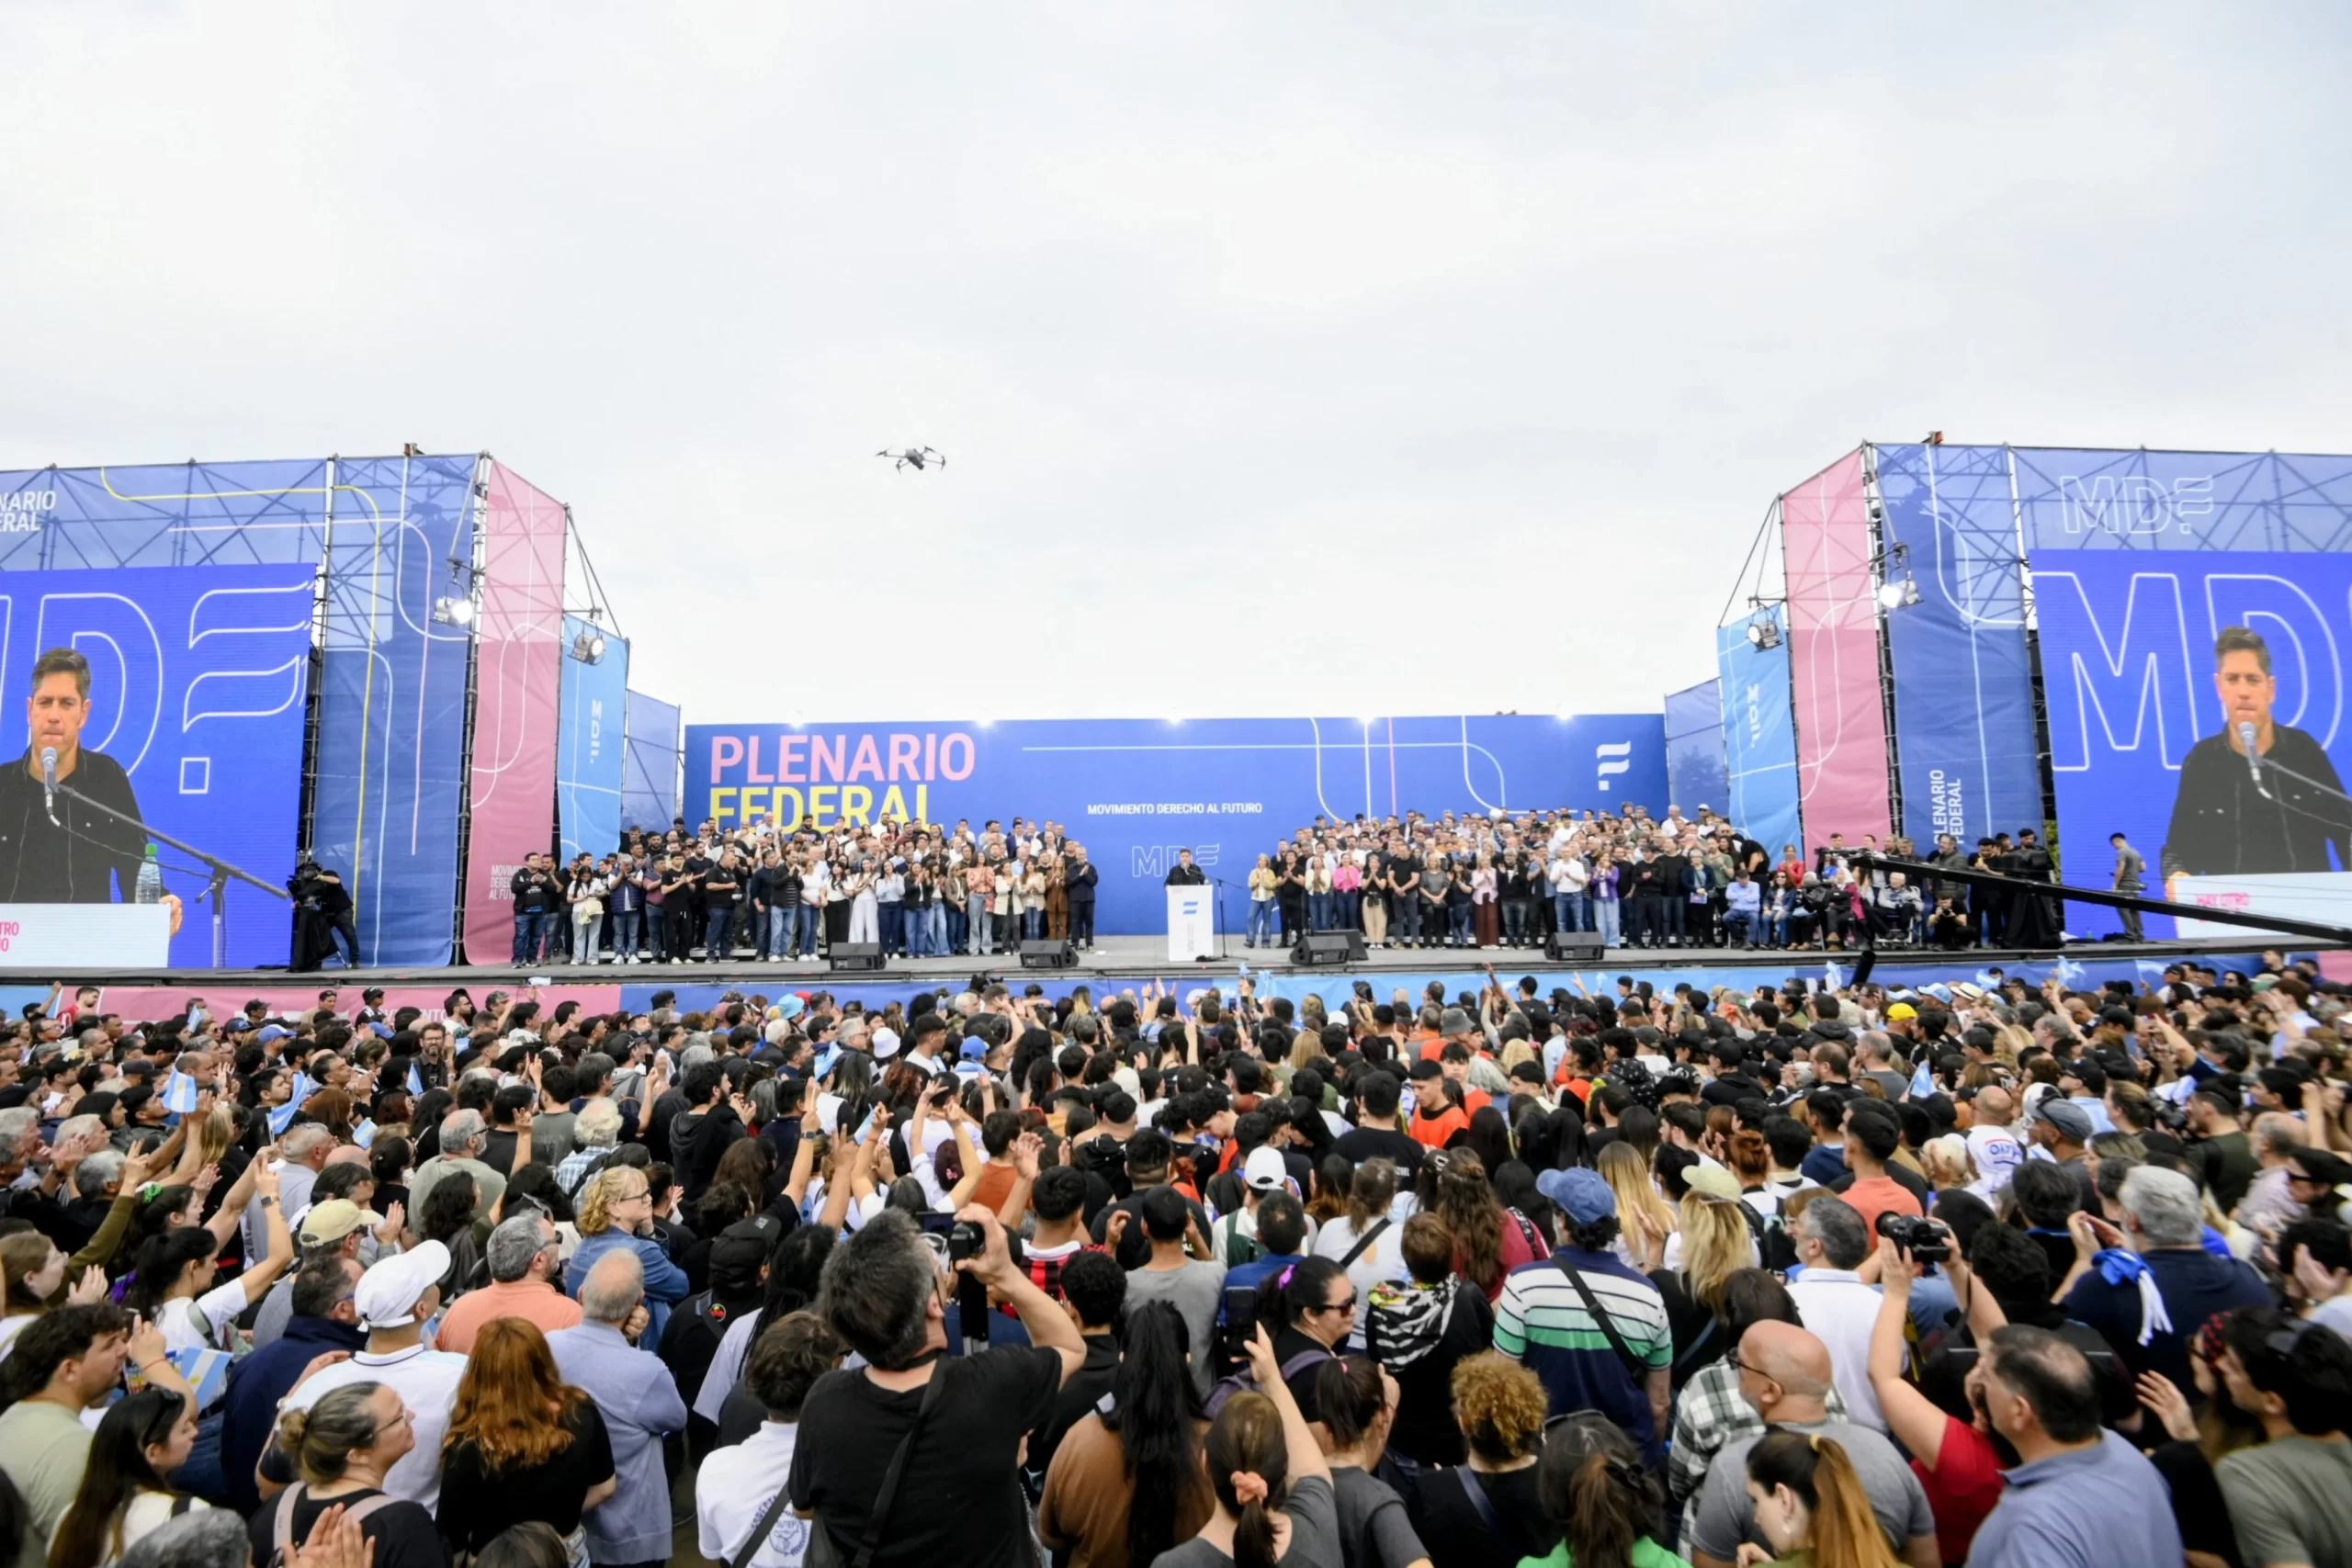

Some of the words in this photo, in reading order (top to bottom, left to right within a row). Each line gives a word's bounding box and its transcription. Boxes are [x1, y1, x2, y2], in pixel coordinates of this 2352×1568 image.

[0, 511, 40, 533] RAL
[0, 581, 315, 795] DF
[2030, 570, 2352, 771] MD
[710, 732, 976, 784] PLENARIO
[709, 784, 944, 837] FEDERAL
[1087, 804, 1155, 815] MOVIMIENTO
[1157, 803, 1204, 814] DERECHO
[1206, 803, 1220, 814] AL
[1222, 802, 1263, 814] FUTURO
[490, 876, 513, 888] DEREC
[491, 864, 526, 876] MOVIMI
